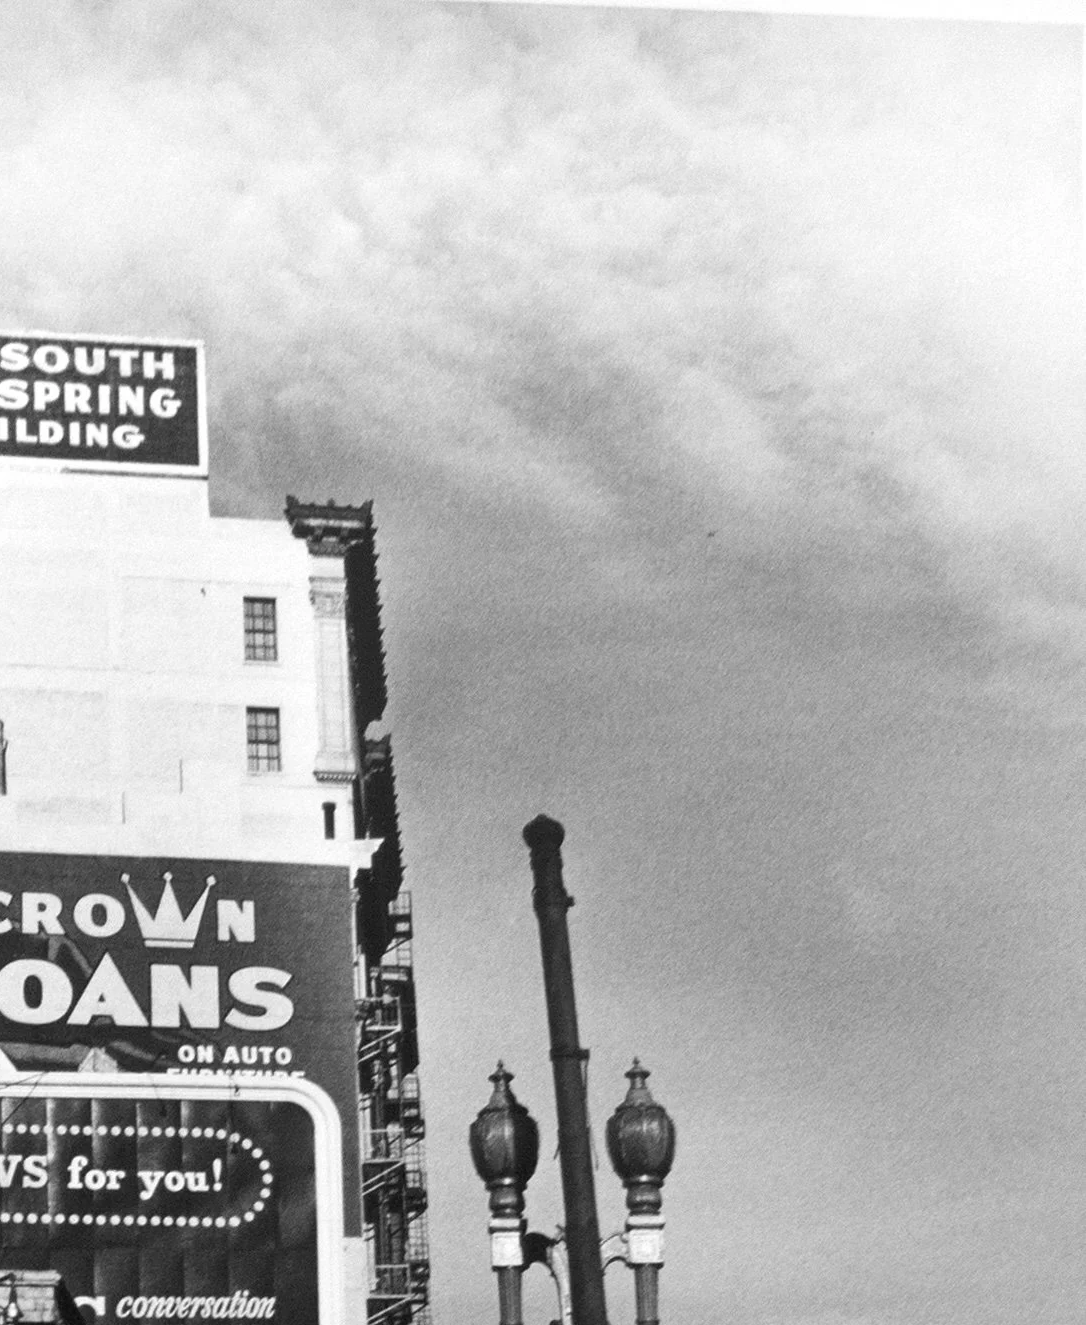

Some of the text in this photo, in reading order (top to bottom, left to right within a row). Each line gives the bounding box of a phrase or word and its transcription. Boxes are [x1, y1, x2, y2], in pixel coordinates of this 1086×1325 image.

[0, 343, 175, 379] SOUTH
[177, 1044, 292, 1065] ON AUTO
[67, 1155, 125, 1190] for
[138, 1158, 223, 1200] you!
[115, 1289, 278, 1319] conversation
